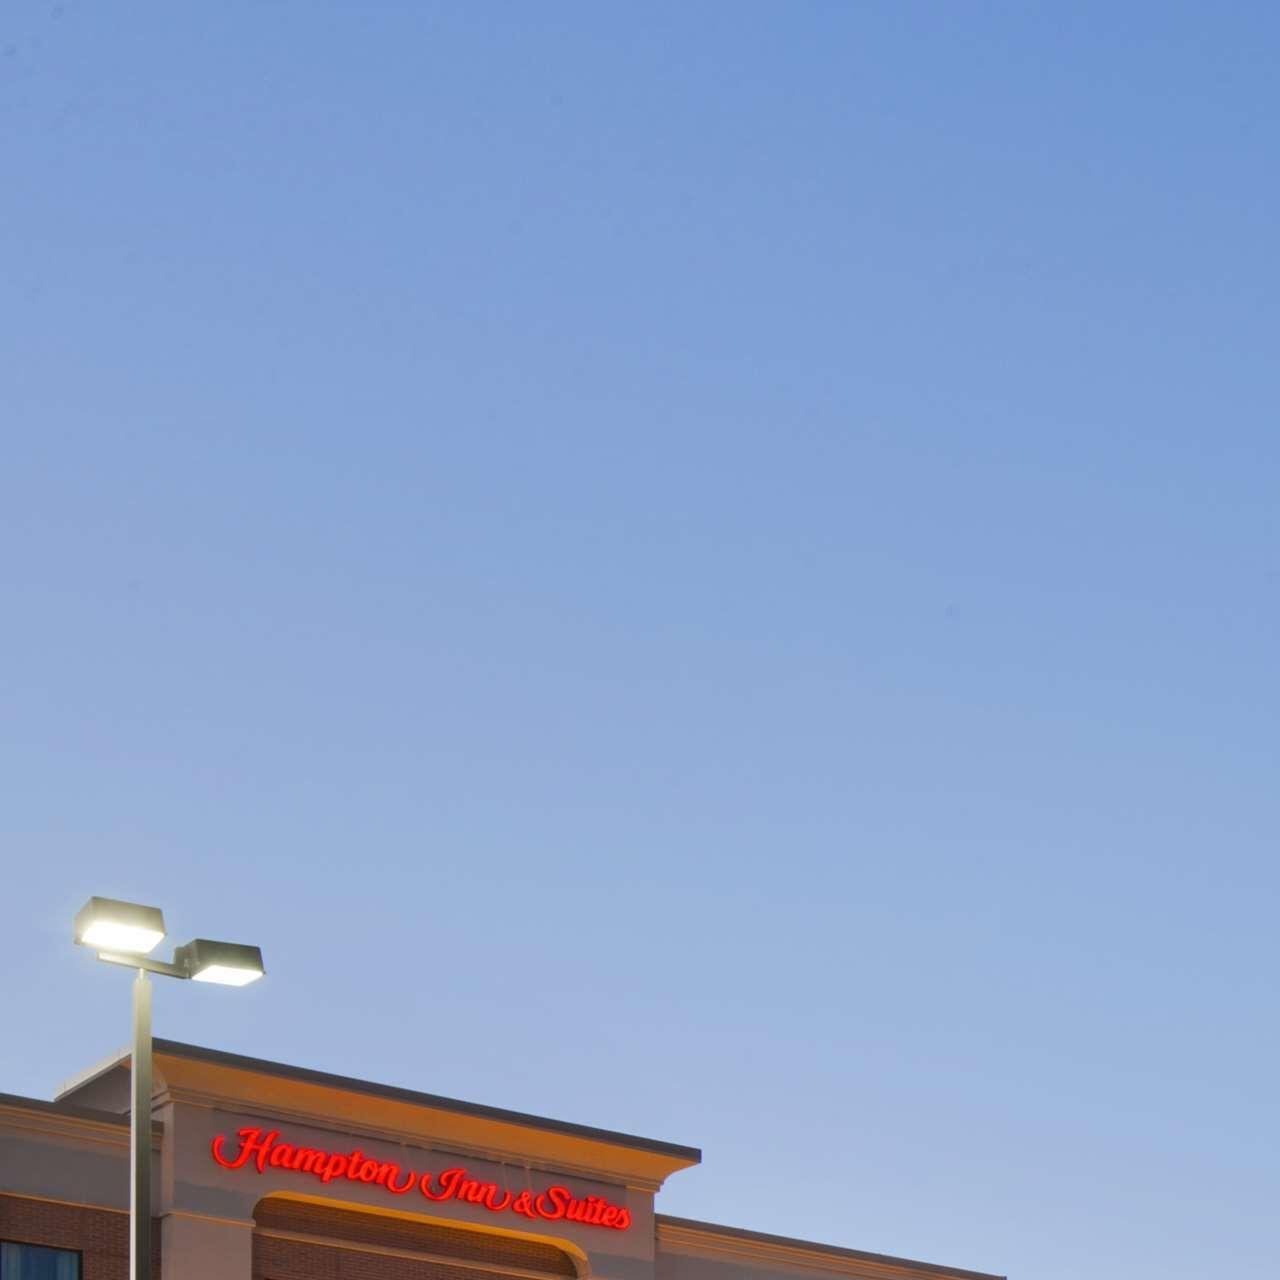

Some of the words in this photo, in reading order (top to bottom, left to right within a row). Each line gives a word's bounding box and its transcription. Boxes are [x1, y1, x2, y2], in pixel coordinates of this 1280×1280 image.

[211, 1126, 416, 1194] Hampton
[418, 1167, 512, 1212] Inn
[511, 1190, 537, 1219] &
[534, 1185, 632, 1231] Suites
